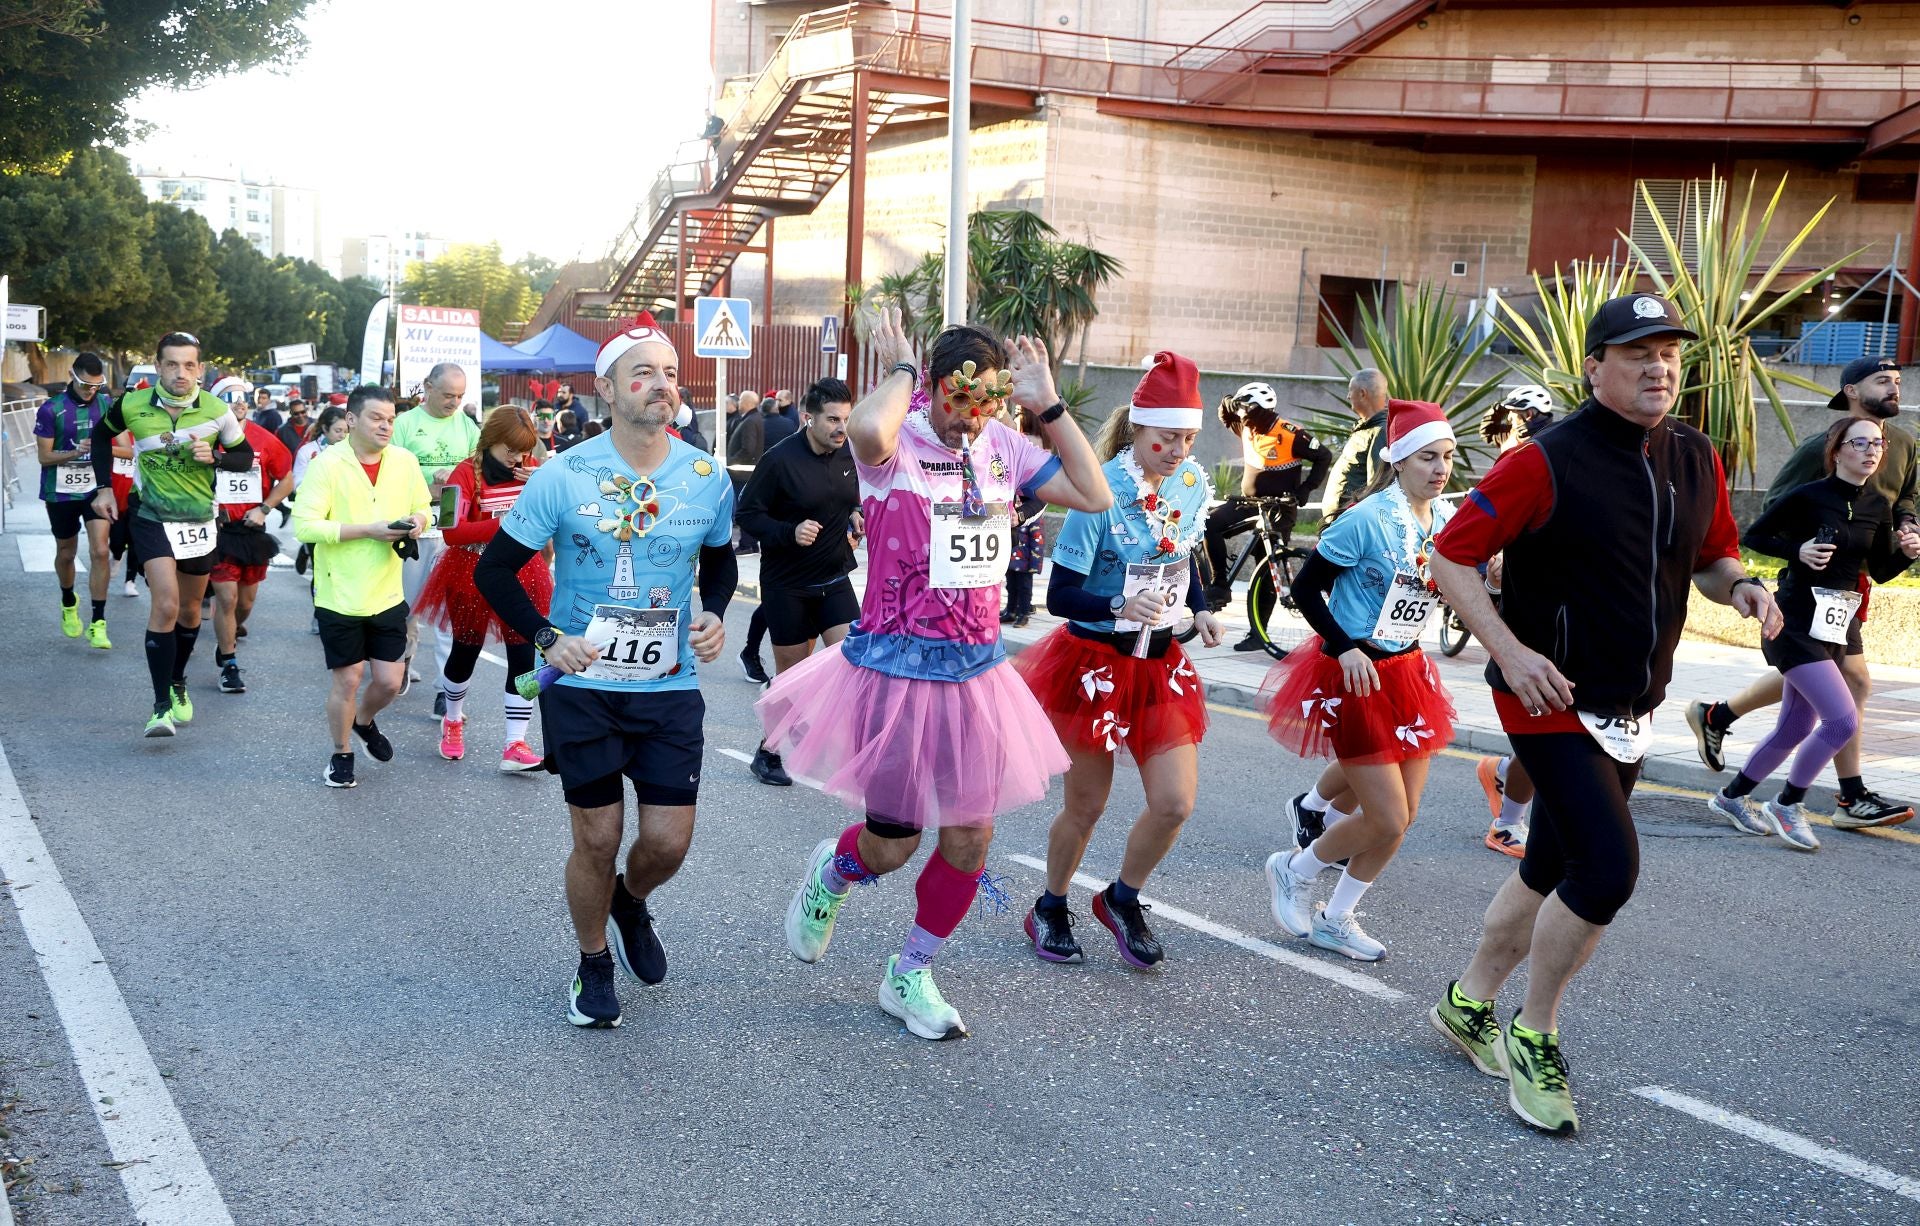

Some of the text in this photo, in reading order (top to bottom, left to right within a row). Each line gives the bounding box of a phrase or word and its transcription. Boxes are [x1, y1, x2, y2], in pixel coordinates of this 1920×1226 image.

[404, 308, 476, 325] SALIDA
[405, 328, 477, 344] XIV CARRERA
[430, 347, 473, 356] SILVESTRE
[404, 355, 479, 366] PALMA PALMILLA
[65, 474, 91, 484] 855
[229, 479, 248, 492] 56
[512, 509, 528, 525] ORT
[177, 527, 209, 545] 154
[950, 534, 1000, 562] 519
[1390, 599, 1429, 622] 865
[1825, 607, 1848, 627] 632
[600, 637, 662, 665] 116
